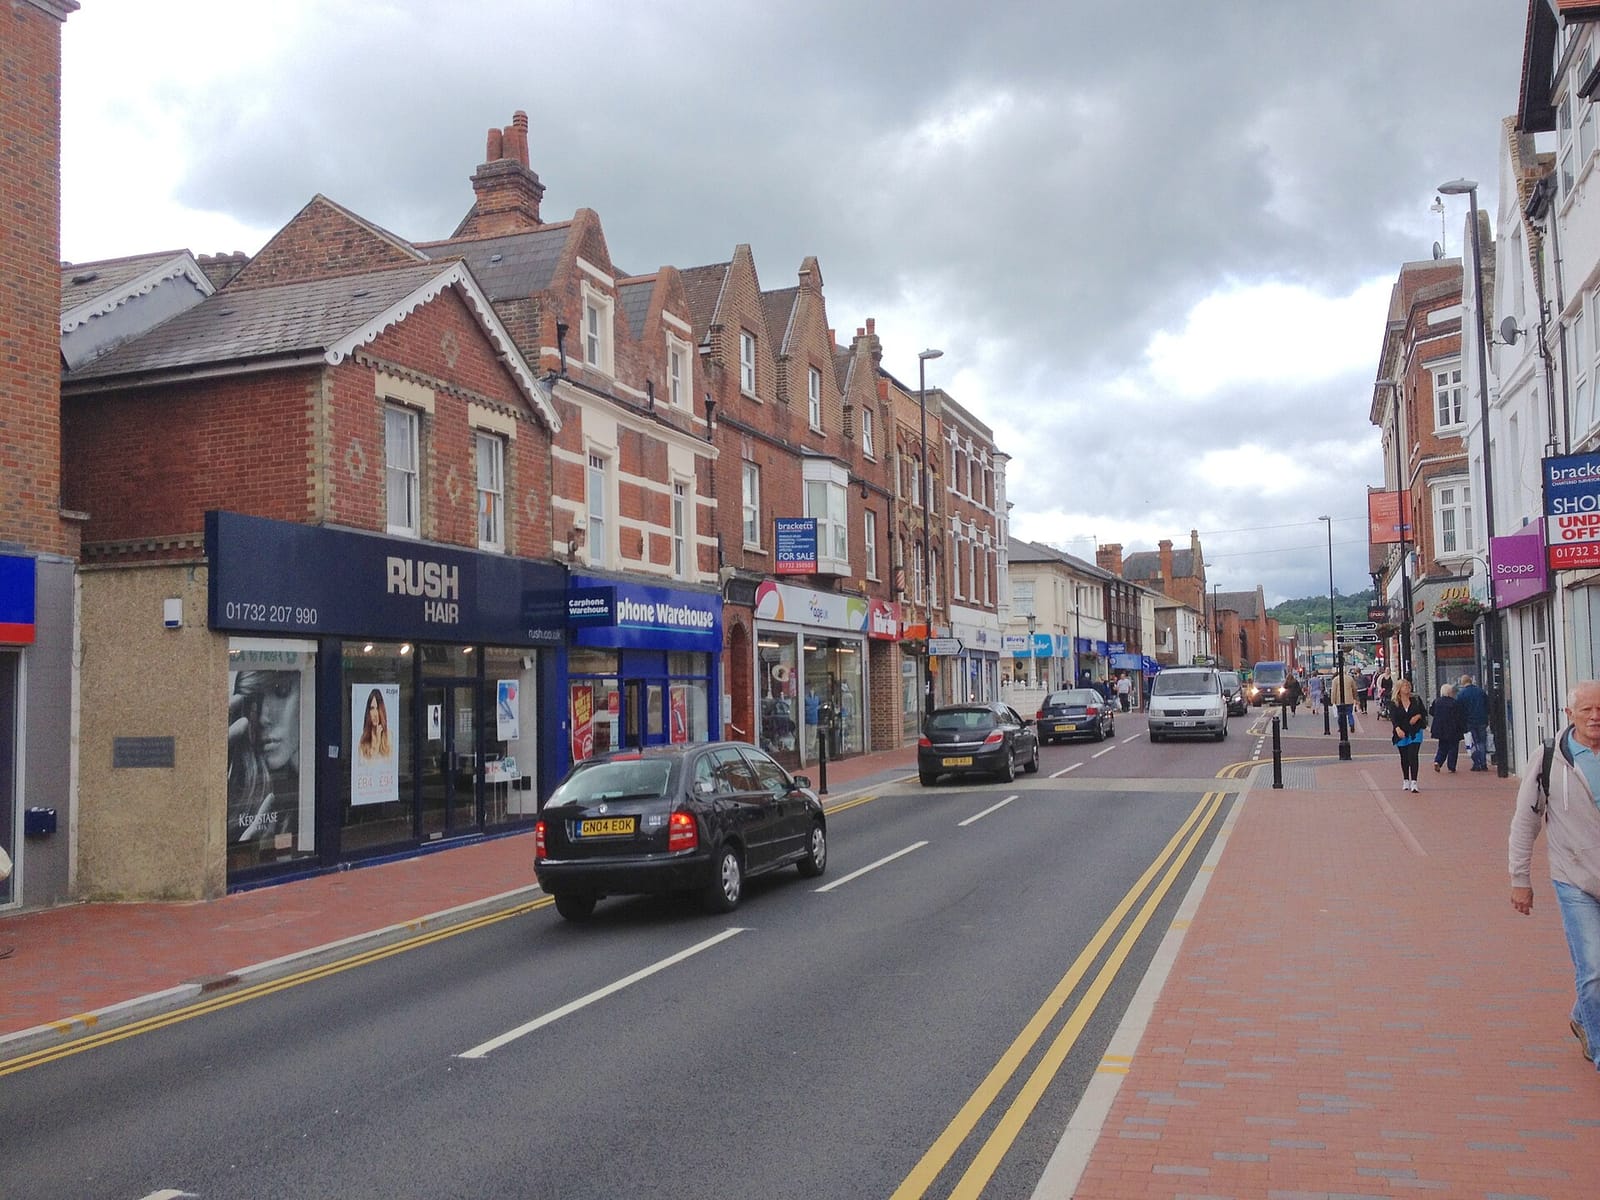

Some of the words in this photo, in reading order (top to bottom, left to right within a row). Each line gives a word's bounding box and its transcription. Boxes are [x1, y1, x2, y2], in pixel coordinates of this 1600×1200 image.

[1553, 495, 1600, 514] SHO
[778, 521, 814, 530] bracketts
[779, 552, 795, 561] FOR
[796, 552, 815, 561] SALE
[1556, 546, 1589, 558] 01732
[1497, 563, 1535, 575] Scope
[387, 556, 459, 600] RUSH
[569, 598, 605, 608] Carphone
[226, 602, 266, 623] 01732
[270, 605, 293, 624] 207
[295, 608, 318, 625] 990
[424, 600, 459, 625] HAIR
[569, 606, 609, 615] Warehouse
[617, 598, 655, 624] phone
[656, 603, 714, 628] Warehouse
[238, 811, 279, 827] KÉRSTASE
[583, 821, 609, 833] GN04
[611, 819, 632, 831] EOK
